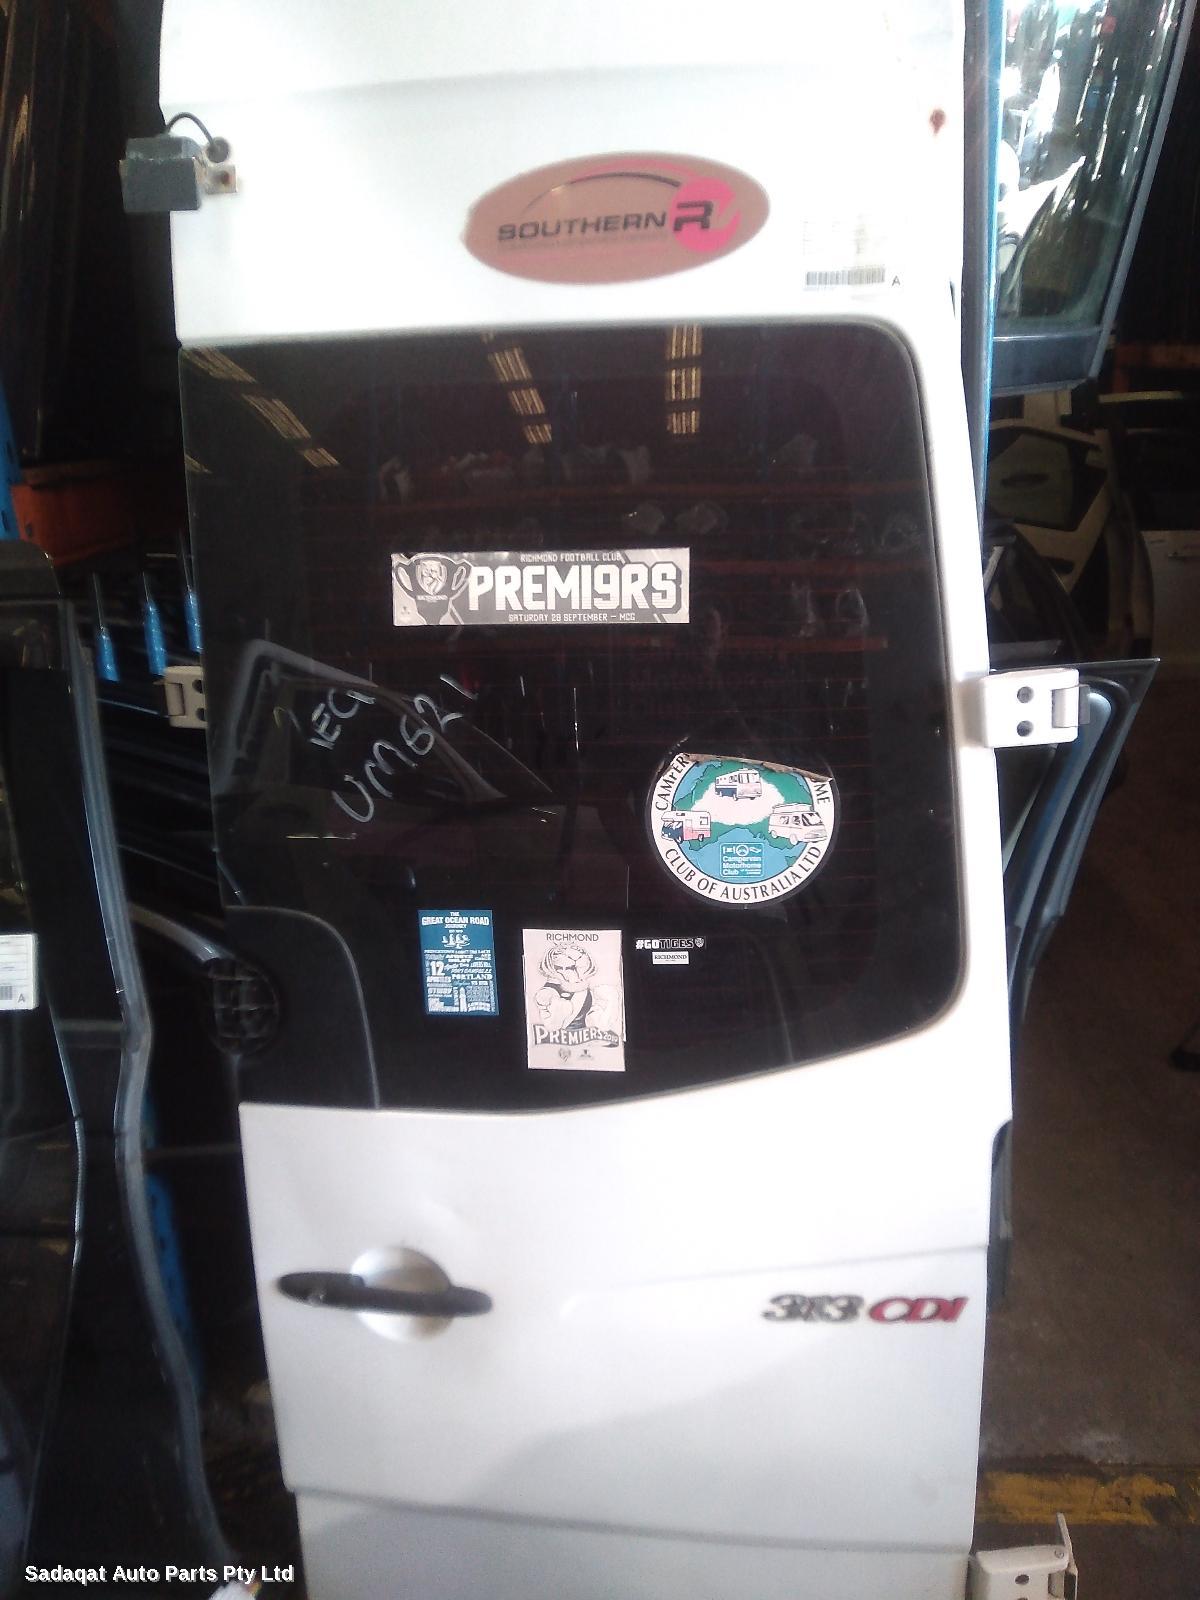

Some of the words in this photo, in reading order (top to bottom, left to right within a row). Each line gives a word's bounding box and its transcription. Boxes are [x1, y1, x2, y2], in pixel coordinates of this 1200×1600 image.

[497, 212, 667, 241] SOUTHERN
[891, 275, 901, 286] A
[520, 553, 558, 563] RICHMOND
[560, 552, 600, 562] FOOTBALL
[602, 551, 621, 561] CLUB
[468, 562, 677, 610] PREMI9RS
[508, 614, 549, 622] SATURDAY
[551, 613, 561, 622] 28
[563, 613, 608, 622] SEPTEMBER
[619, 612, 636, 621] MCG
[654, 753, 690, 811] CAMPER
[665, 848, 693, 882] CLUB
[697, 878, 718, 894] OF
[720, 870, 803, 901] AUSTRALIA
[802, 846, 821, 873] LTD
[421, 917, 443, 926] GREAT
[470, 917, 490, 926] ROAD
[546, 932, 599, 943] RICHMOND
[430, 961, 446, 976] 12
[17, 993, 26, 1003] A
[535, 1024, 602, 1045] PREMIERS
